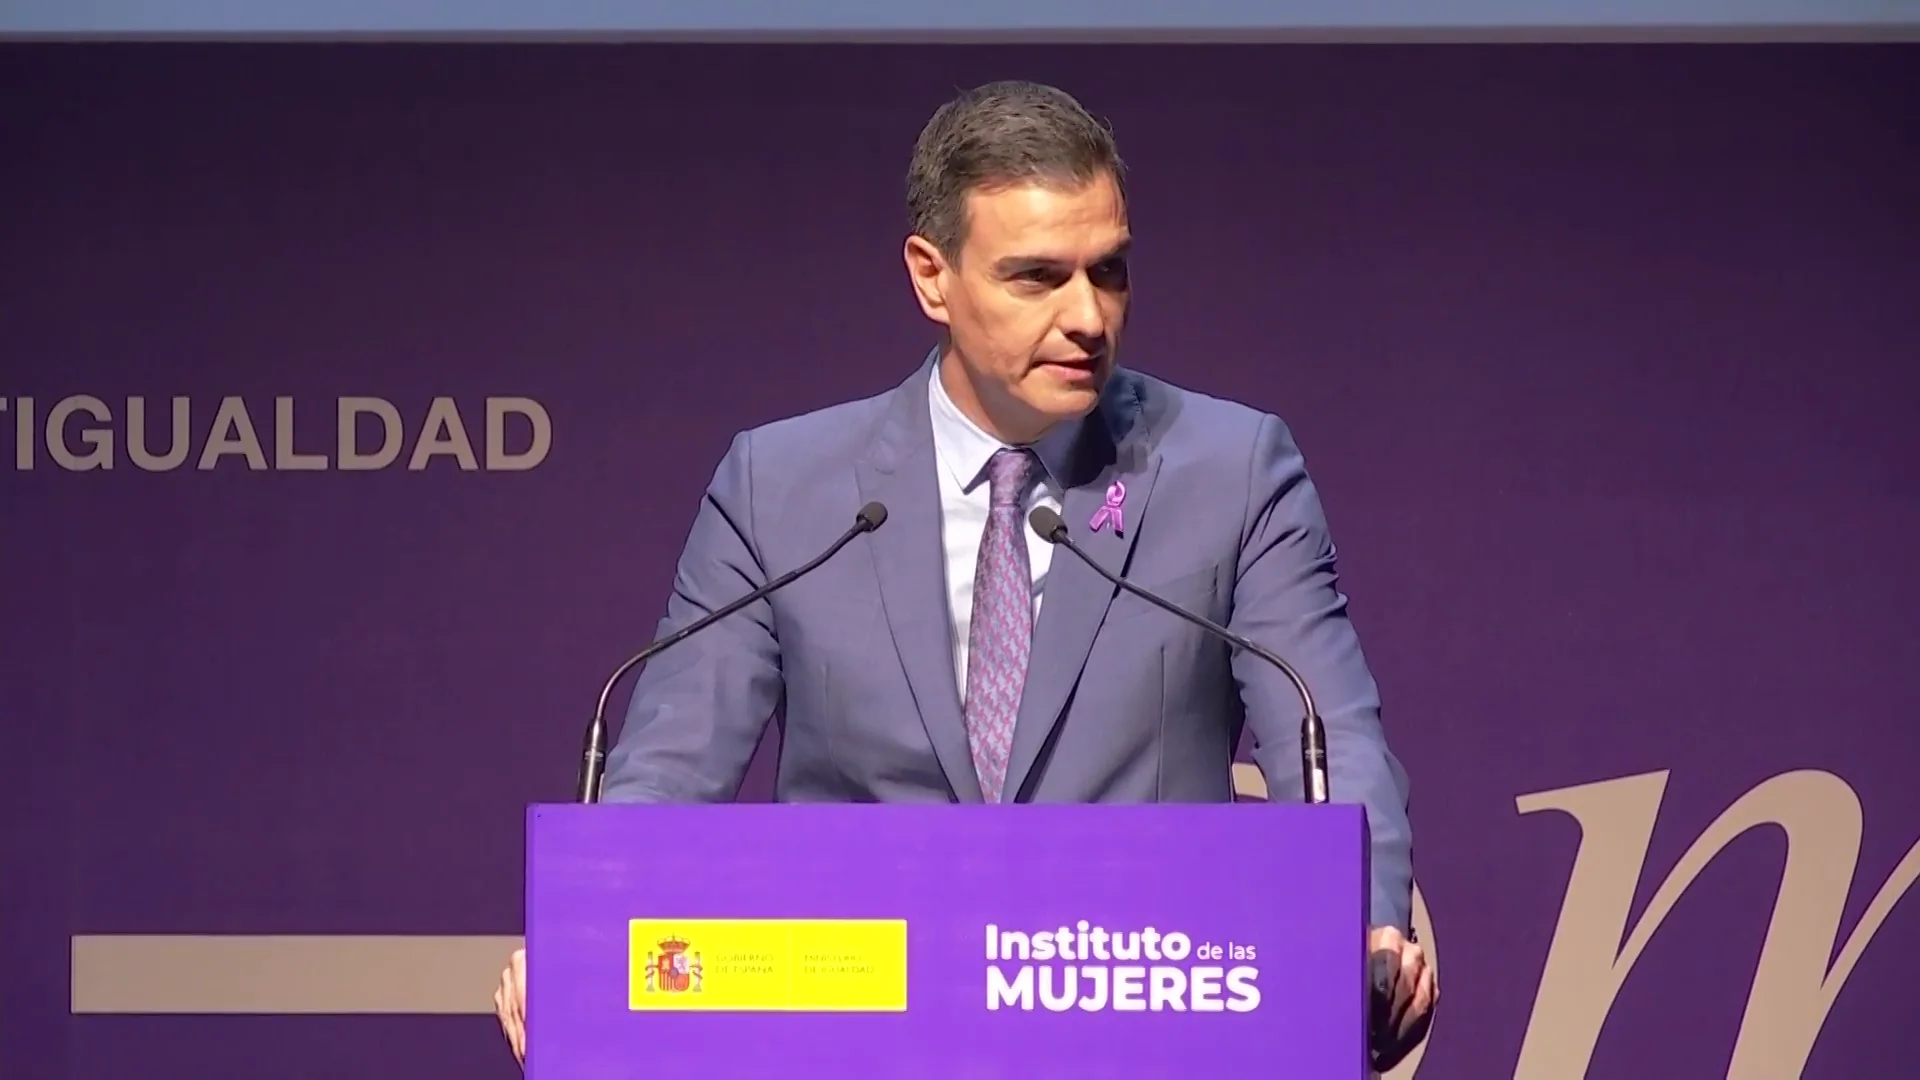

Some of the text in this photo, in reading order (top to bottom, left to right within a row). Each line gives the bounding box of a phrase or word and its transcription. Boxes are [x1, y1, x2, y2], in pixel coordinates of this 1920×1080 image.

[0, 394, 554, 472] IGUALDAD
[985, 919, 1257, 961] Instituto de las
[986, 965, 1261, 1013] MUJERES
